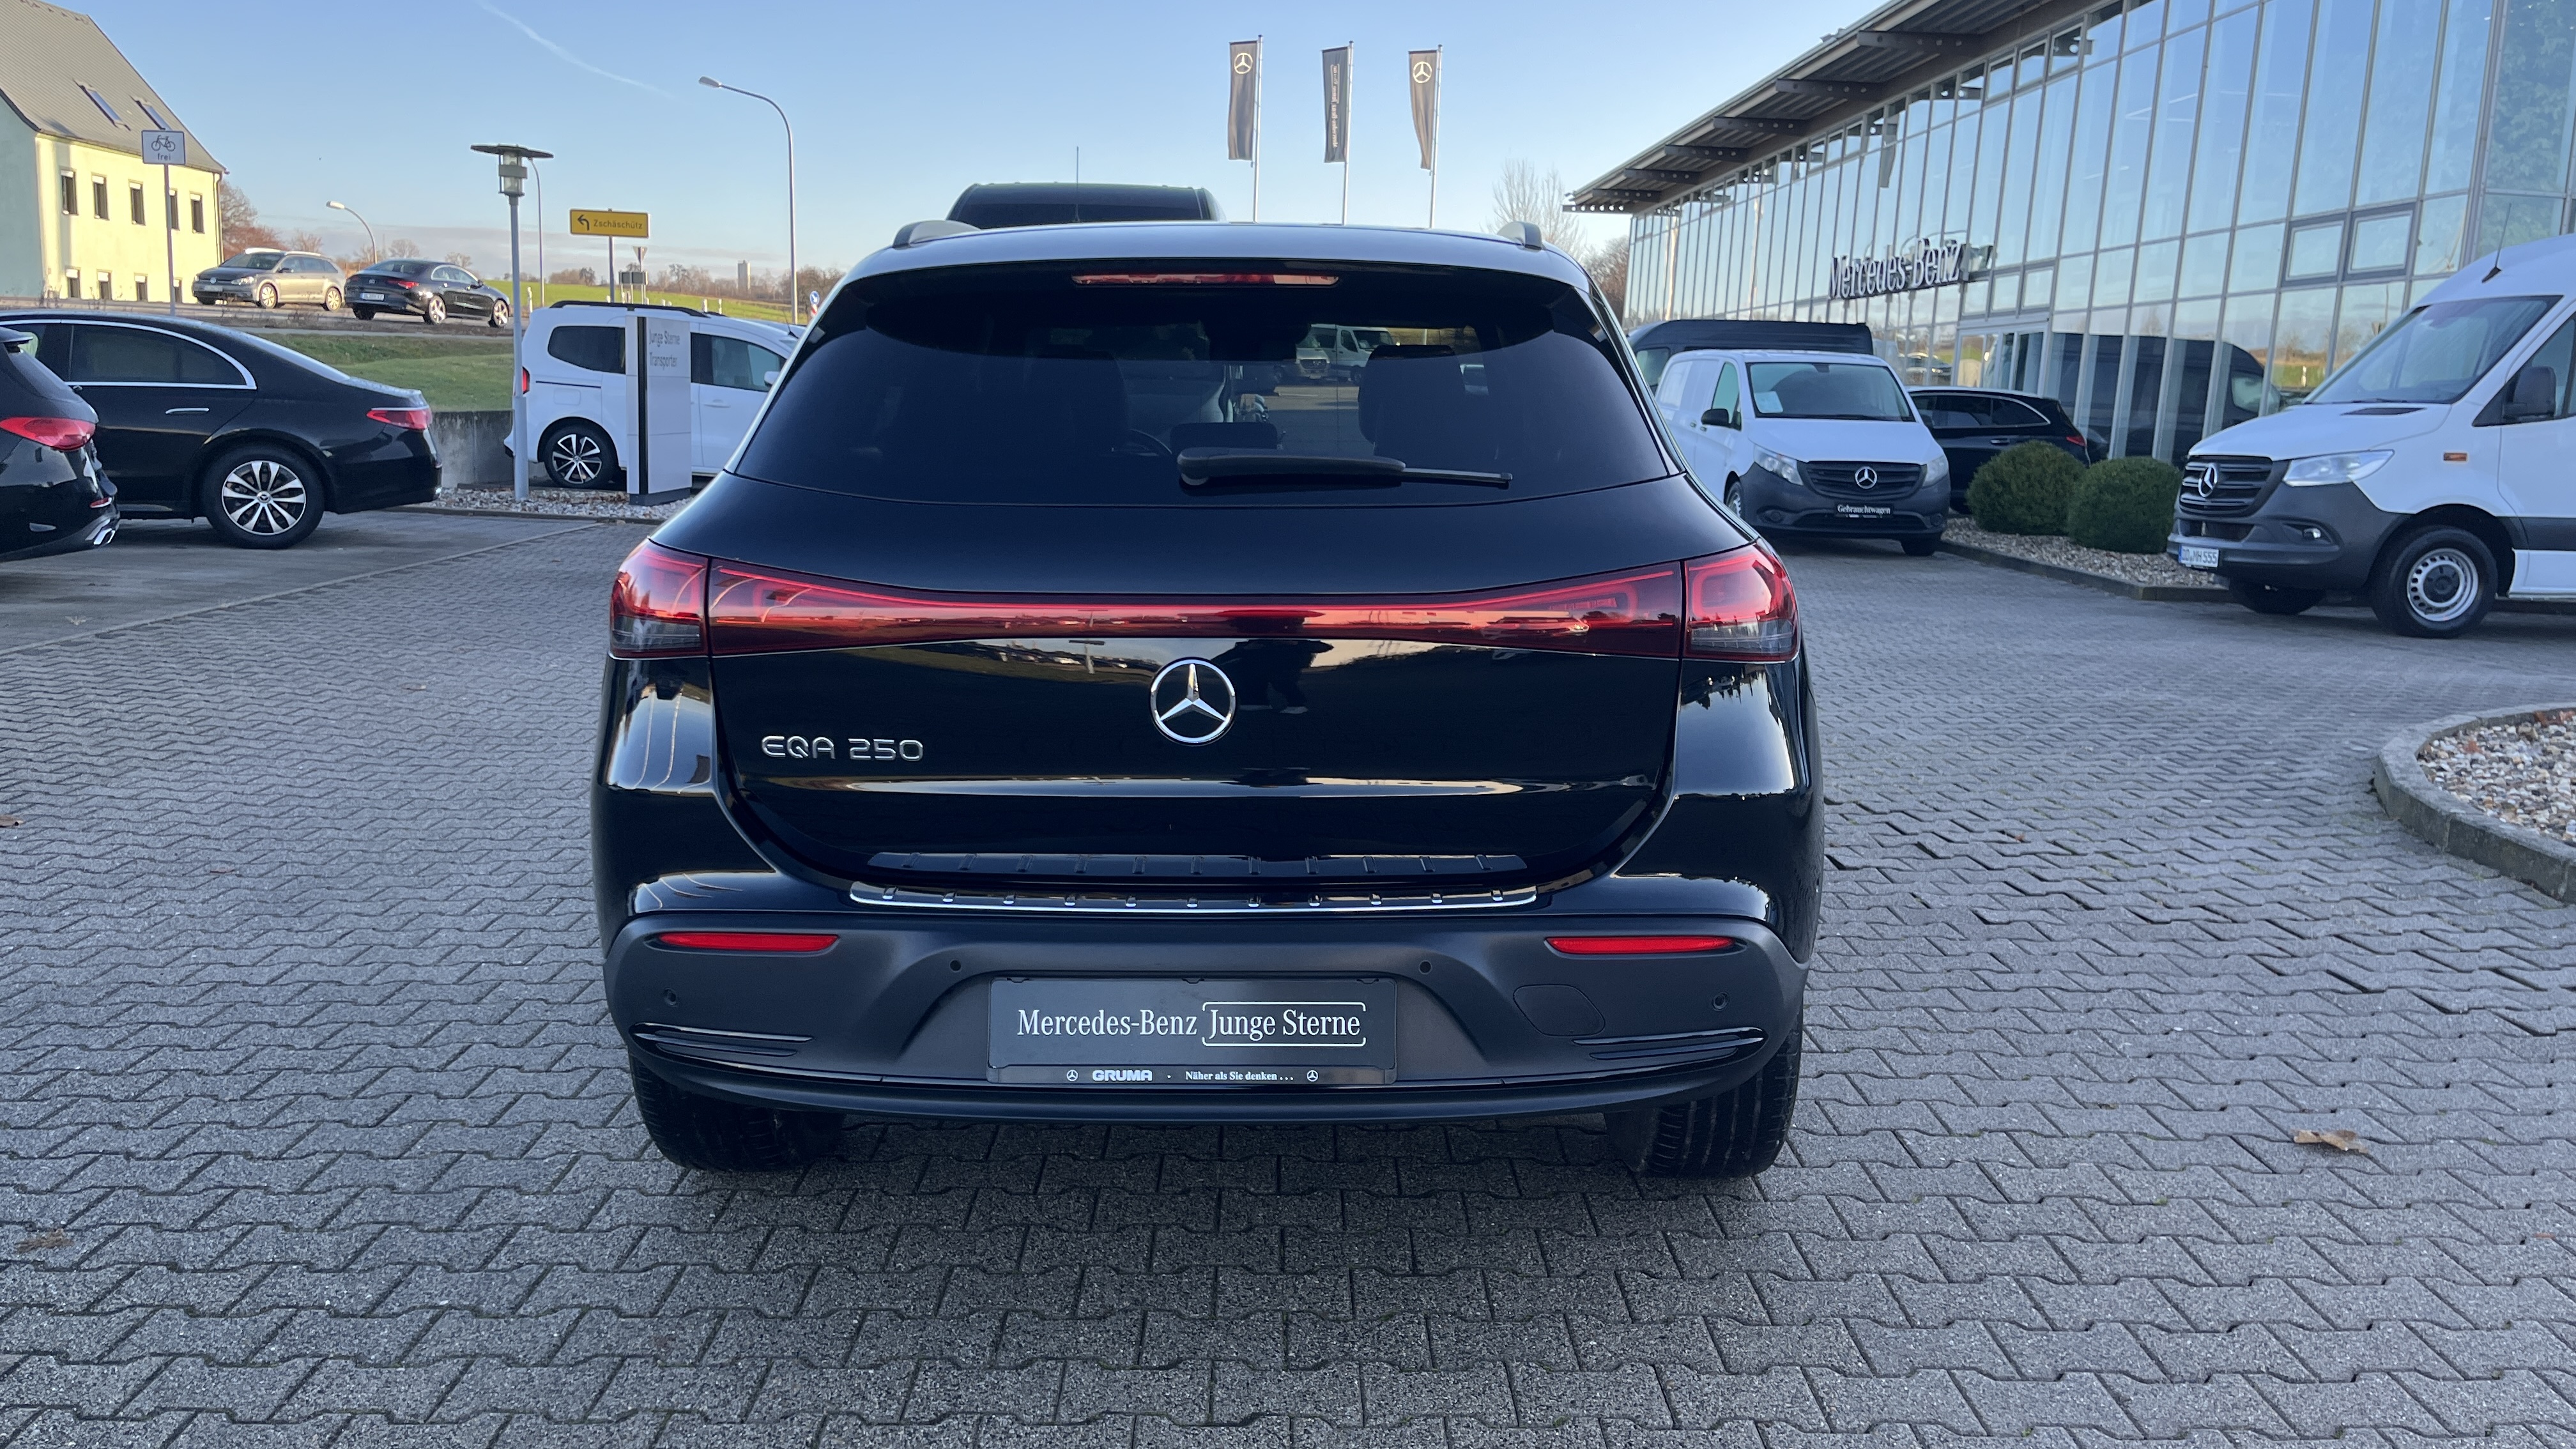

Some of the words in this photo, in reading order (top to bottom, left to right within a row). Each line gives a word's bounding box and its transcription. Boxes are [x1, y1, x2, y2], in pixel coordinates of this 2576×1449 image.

[594, 218, 643, 229] Zschäschütz
[1829, 237, 1961, 298] Mercedes-Benz
[1837, 504, 1890, 515] Gebrauchtwagen
[762, 735, 835, 759] EQA
[848, 738, 923, 762] 250
[1017, 1009, 1197, 1036] Mercedes-Benz
[1209, 1009, 1276, 1041] Junge
[1282, 1009, 1361, 1036] Sterne
[1092, 1070, 1153, 1082] GRUMA
[1185, 1071, 1213, 1080] Näher
[1215, 1071, 1228, 1080] als
[1229, 1071, 1243, 1080] Sie
